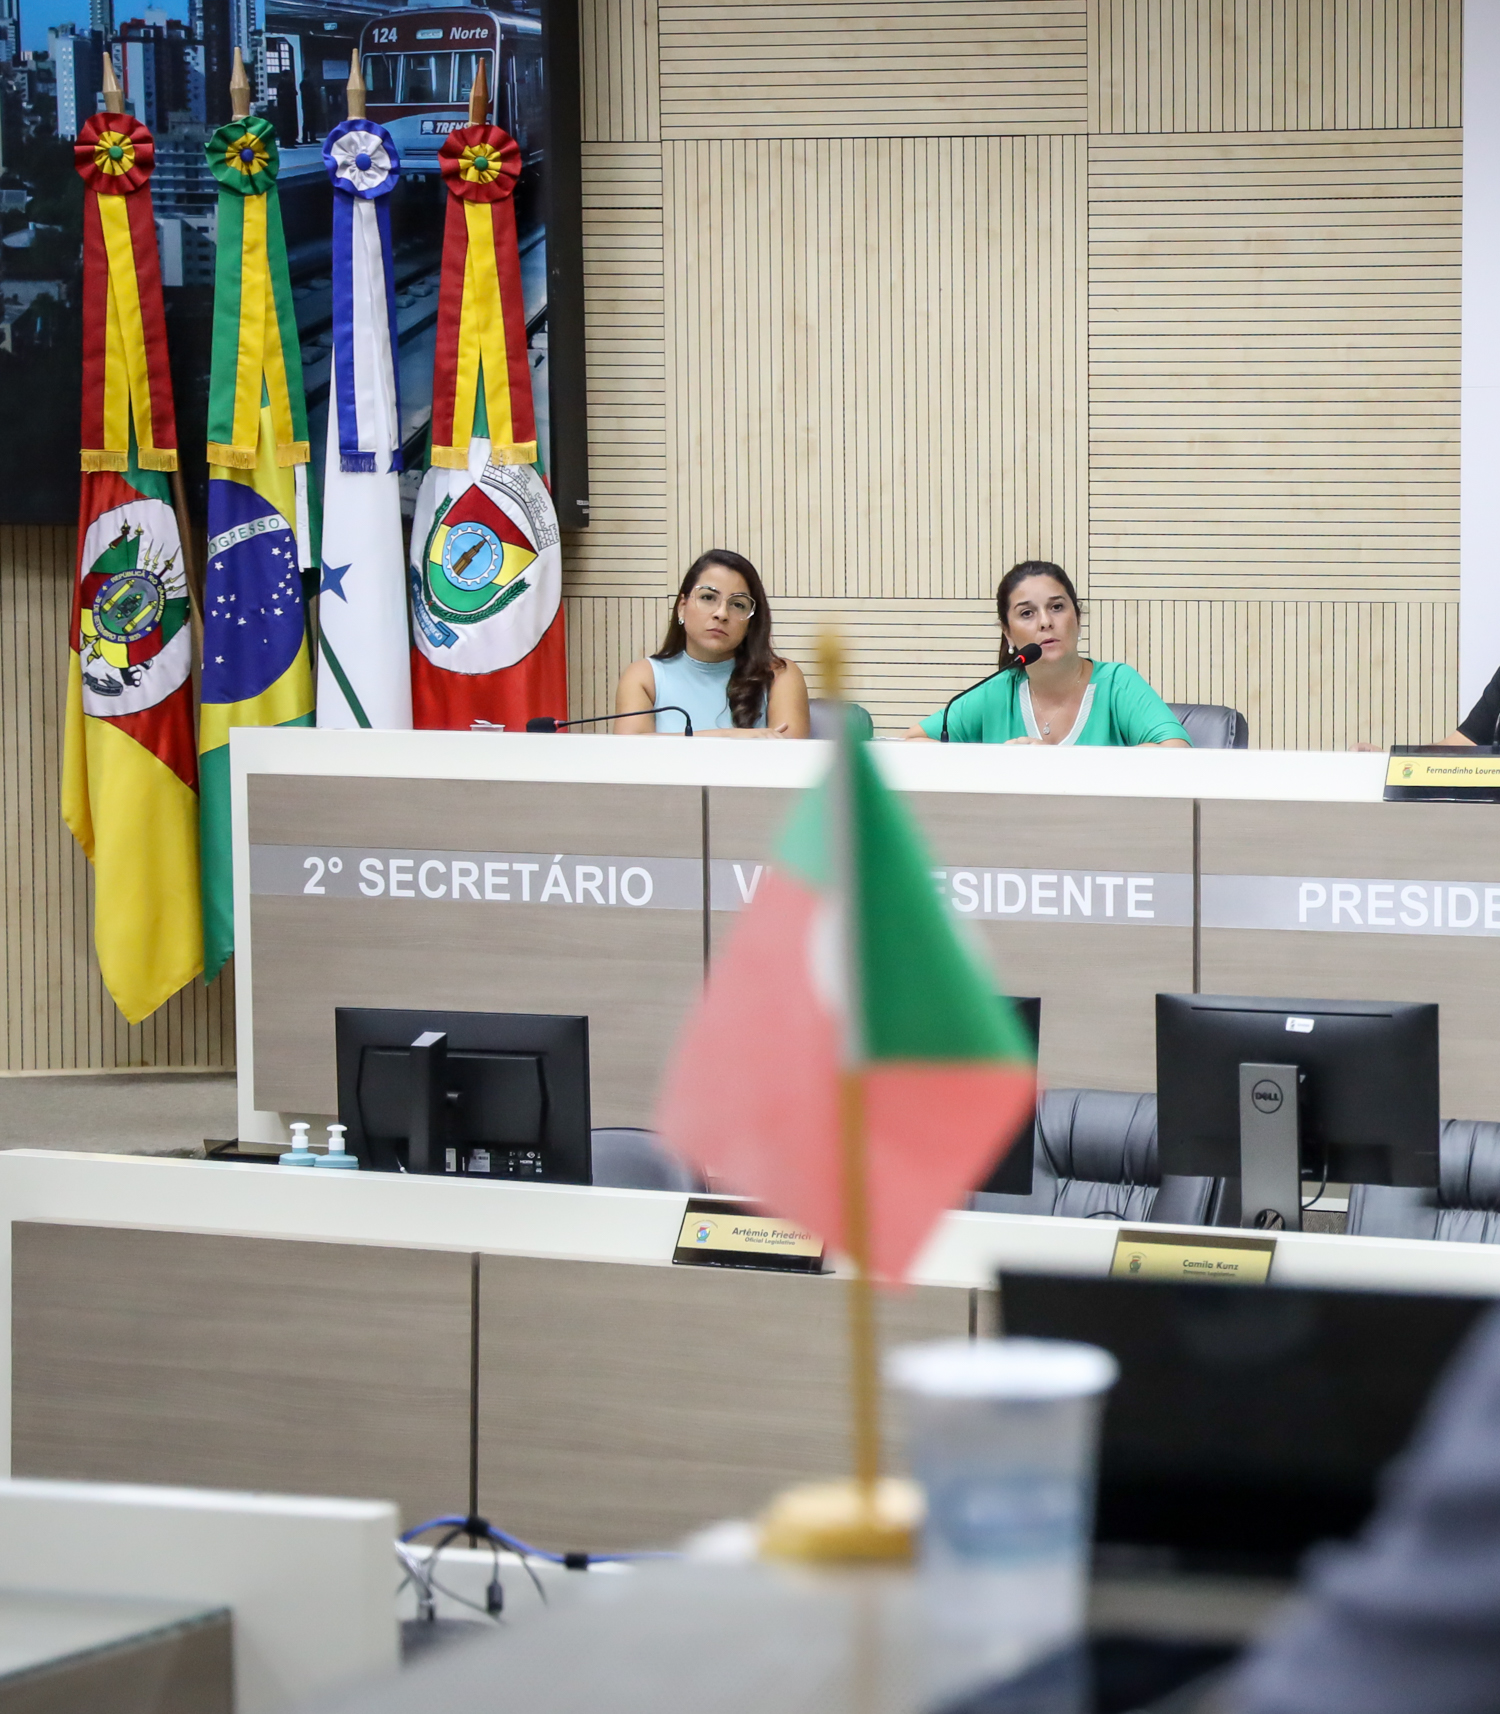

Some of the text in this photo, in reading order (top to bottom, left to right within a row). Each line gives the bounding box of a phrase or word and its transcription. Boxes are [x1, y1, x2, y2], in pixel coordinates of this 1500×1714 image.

[372, 27, 398, 43] 124
[449, 27, 489, 40] Norte
[208, 517, 280, 555] OGRESSO
[1426, 766, 1473, 775] Fernandinho
[359, 855, 654, 906] SECRETÁRIO
[771, 1230, 812, 1240] Friedrich
[1183, 1259, 1239, 1271] Camila Kunz
